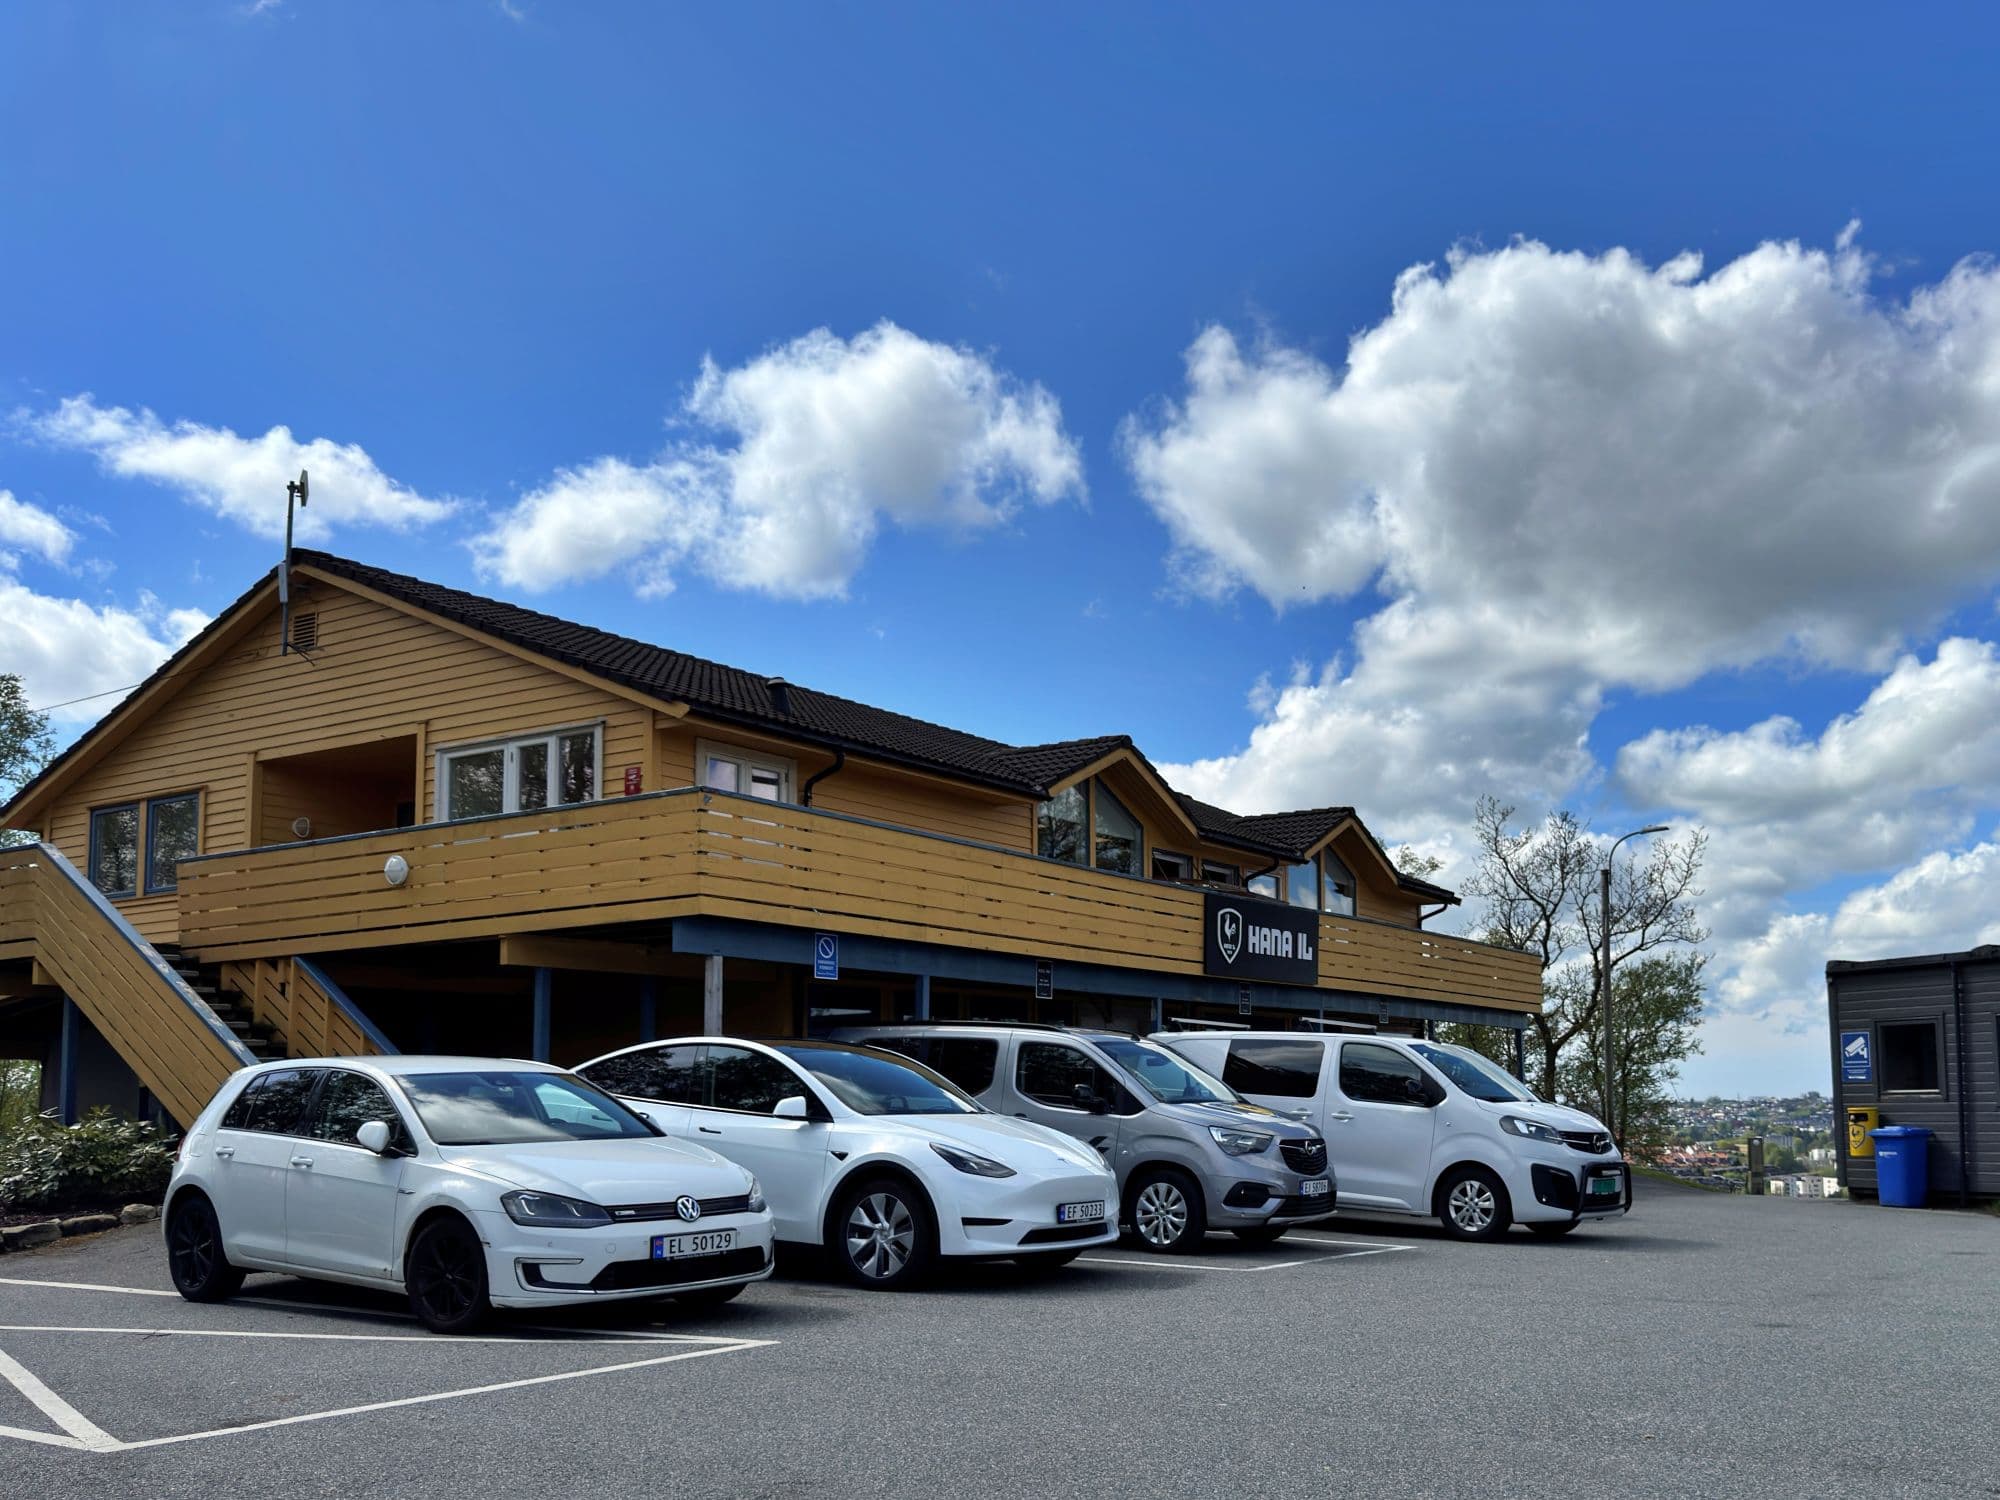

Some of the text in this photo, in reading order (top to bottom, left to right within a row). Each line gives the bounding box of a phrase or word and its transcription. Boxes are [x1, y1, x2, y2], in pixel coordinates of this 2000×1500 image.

[1248, 925, 1313, 960] HANA IL
[1067, 1206, 1077, 1219] EF
[669, 1233, 731, 1254] EL 50129
